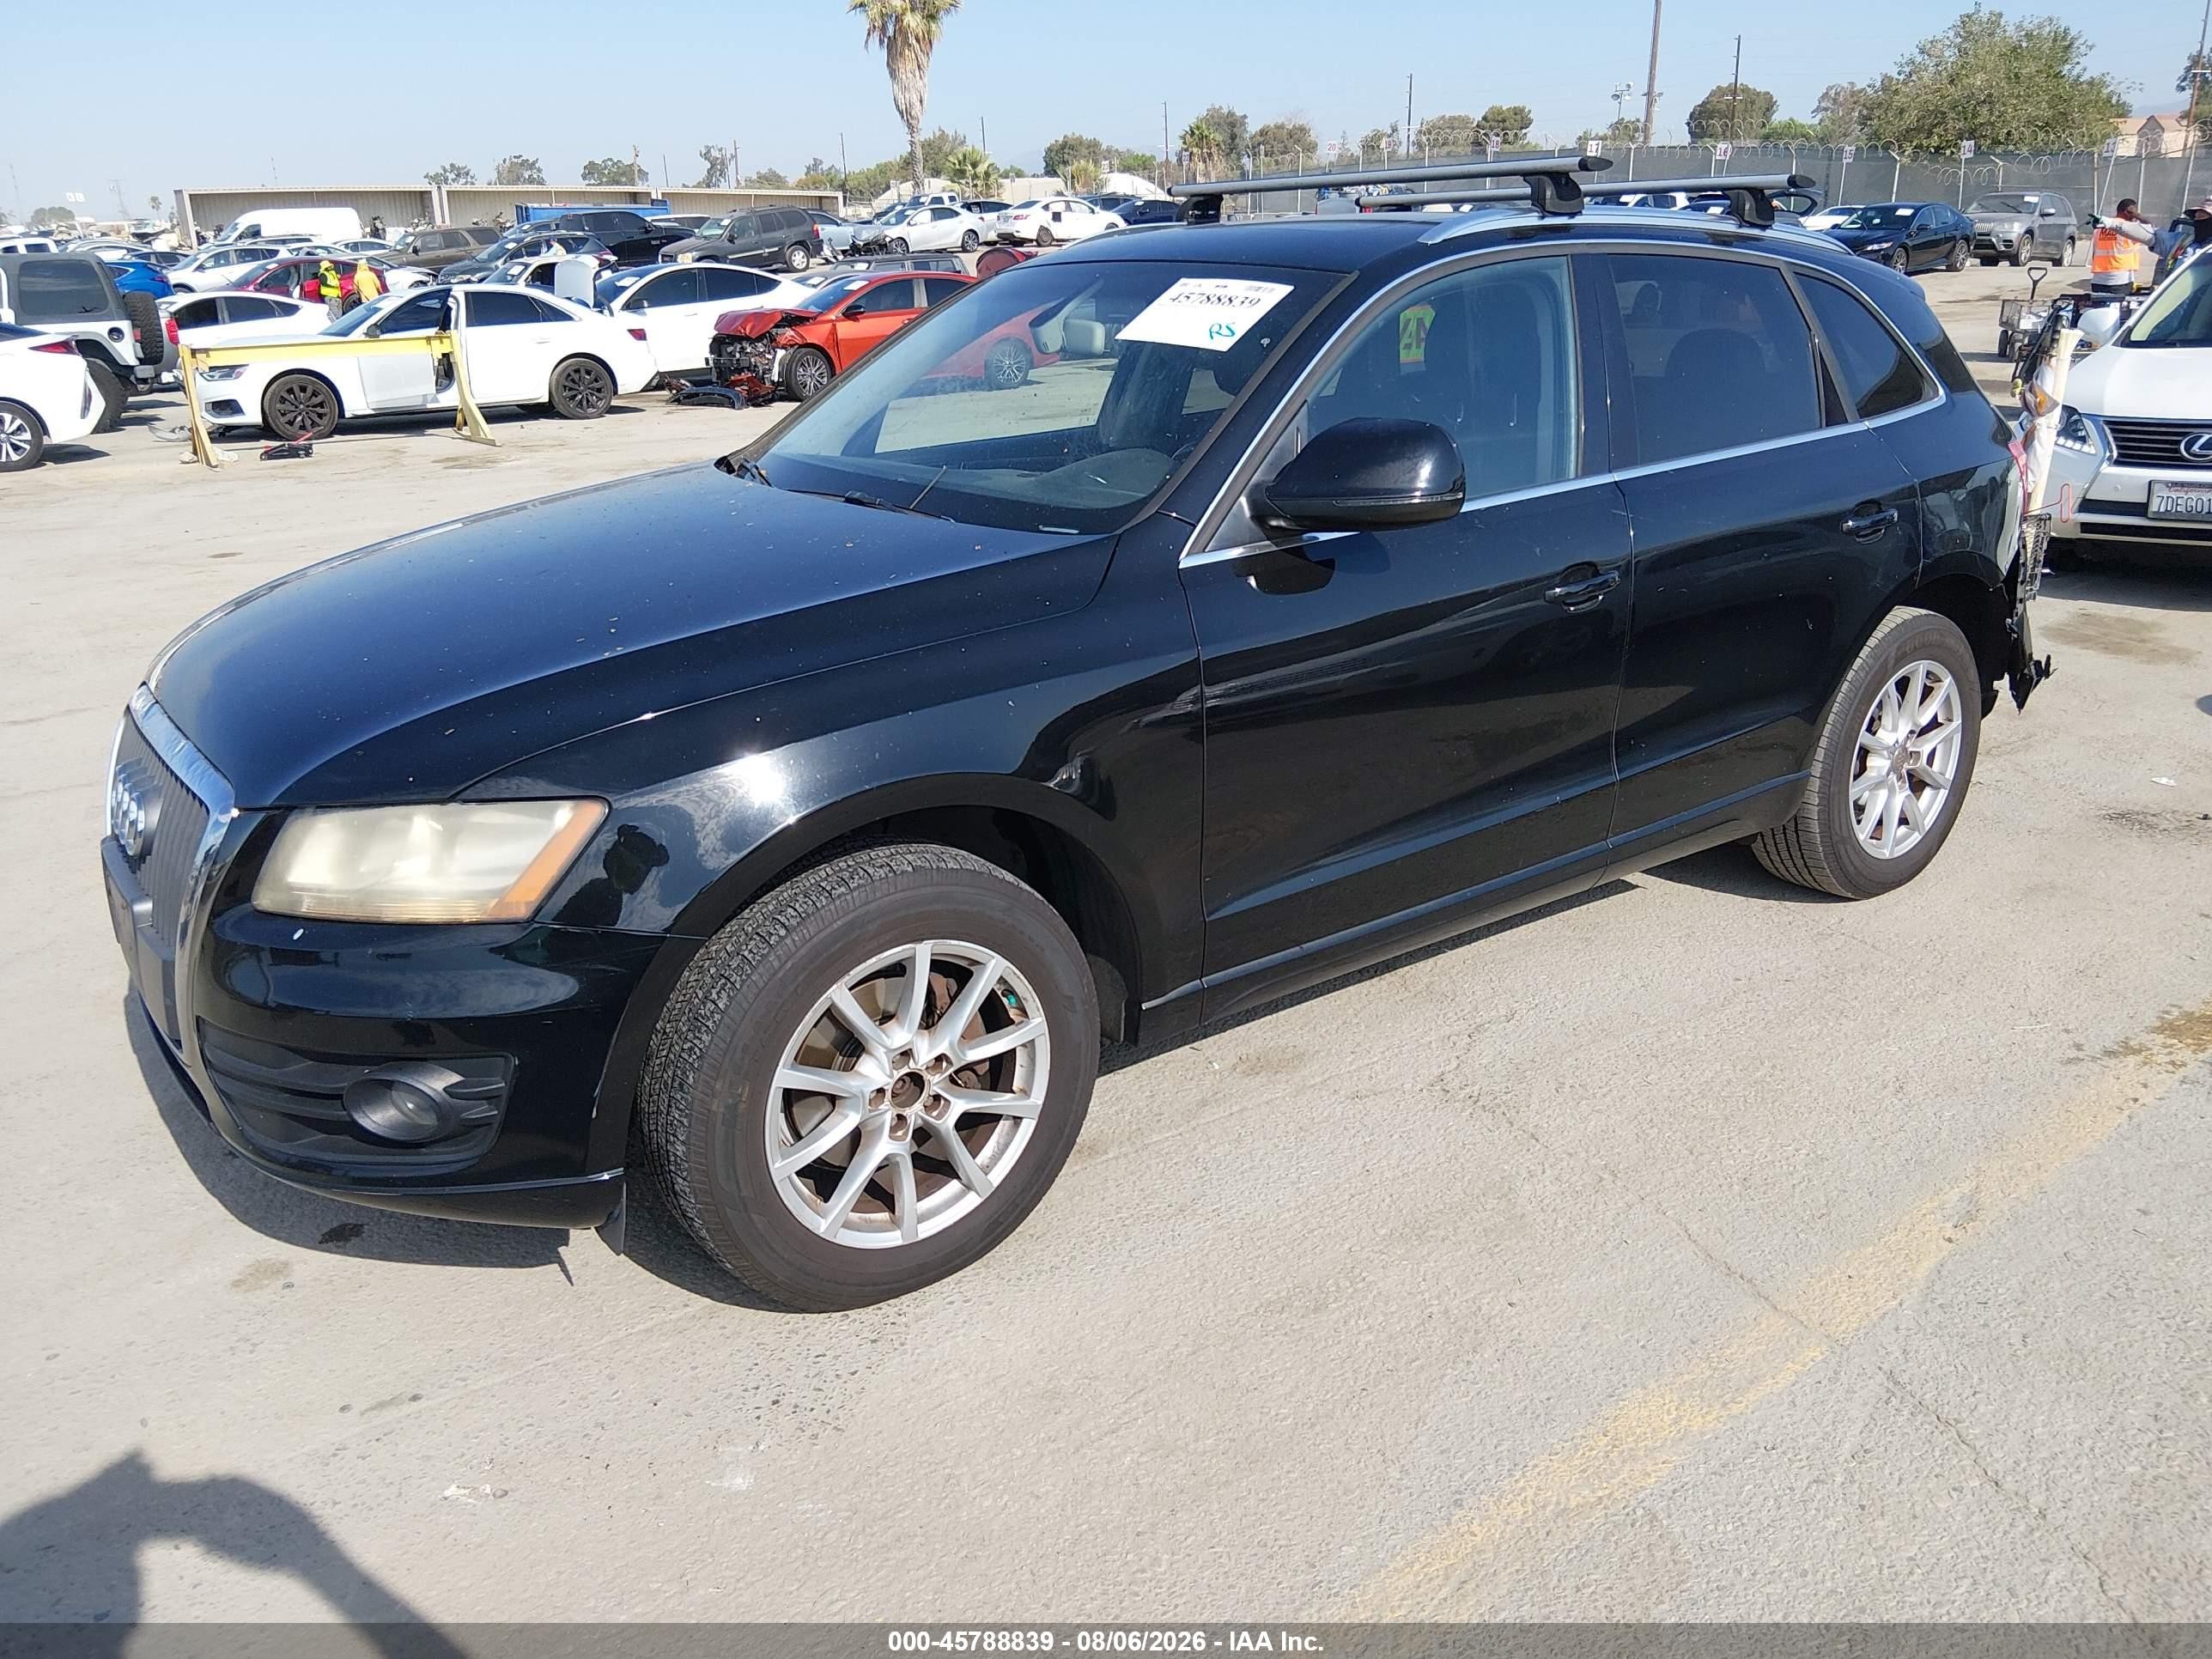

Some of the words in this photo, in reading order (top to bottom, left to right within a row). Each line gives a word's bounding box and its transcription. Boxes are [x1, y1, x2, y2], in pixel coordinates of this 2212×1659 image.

[1328, 143, 1337, 152] 20
[1961, 144, 1973, 155] 14
[1844, 149, 1854, 159] 15
[1170, 292, 1261, 308] 45788839
